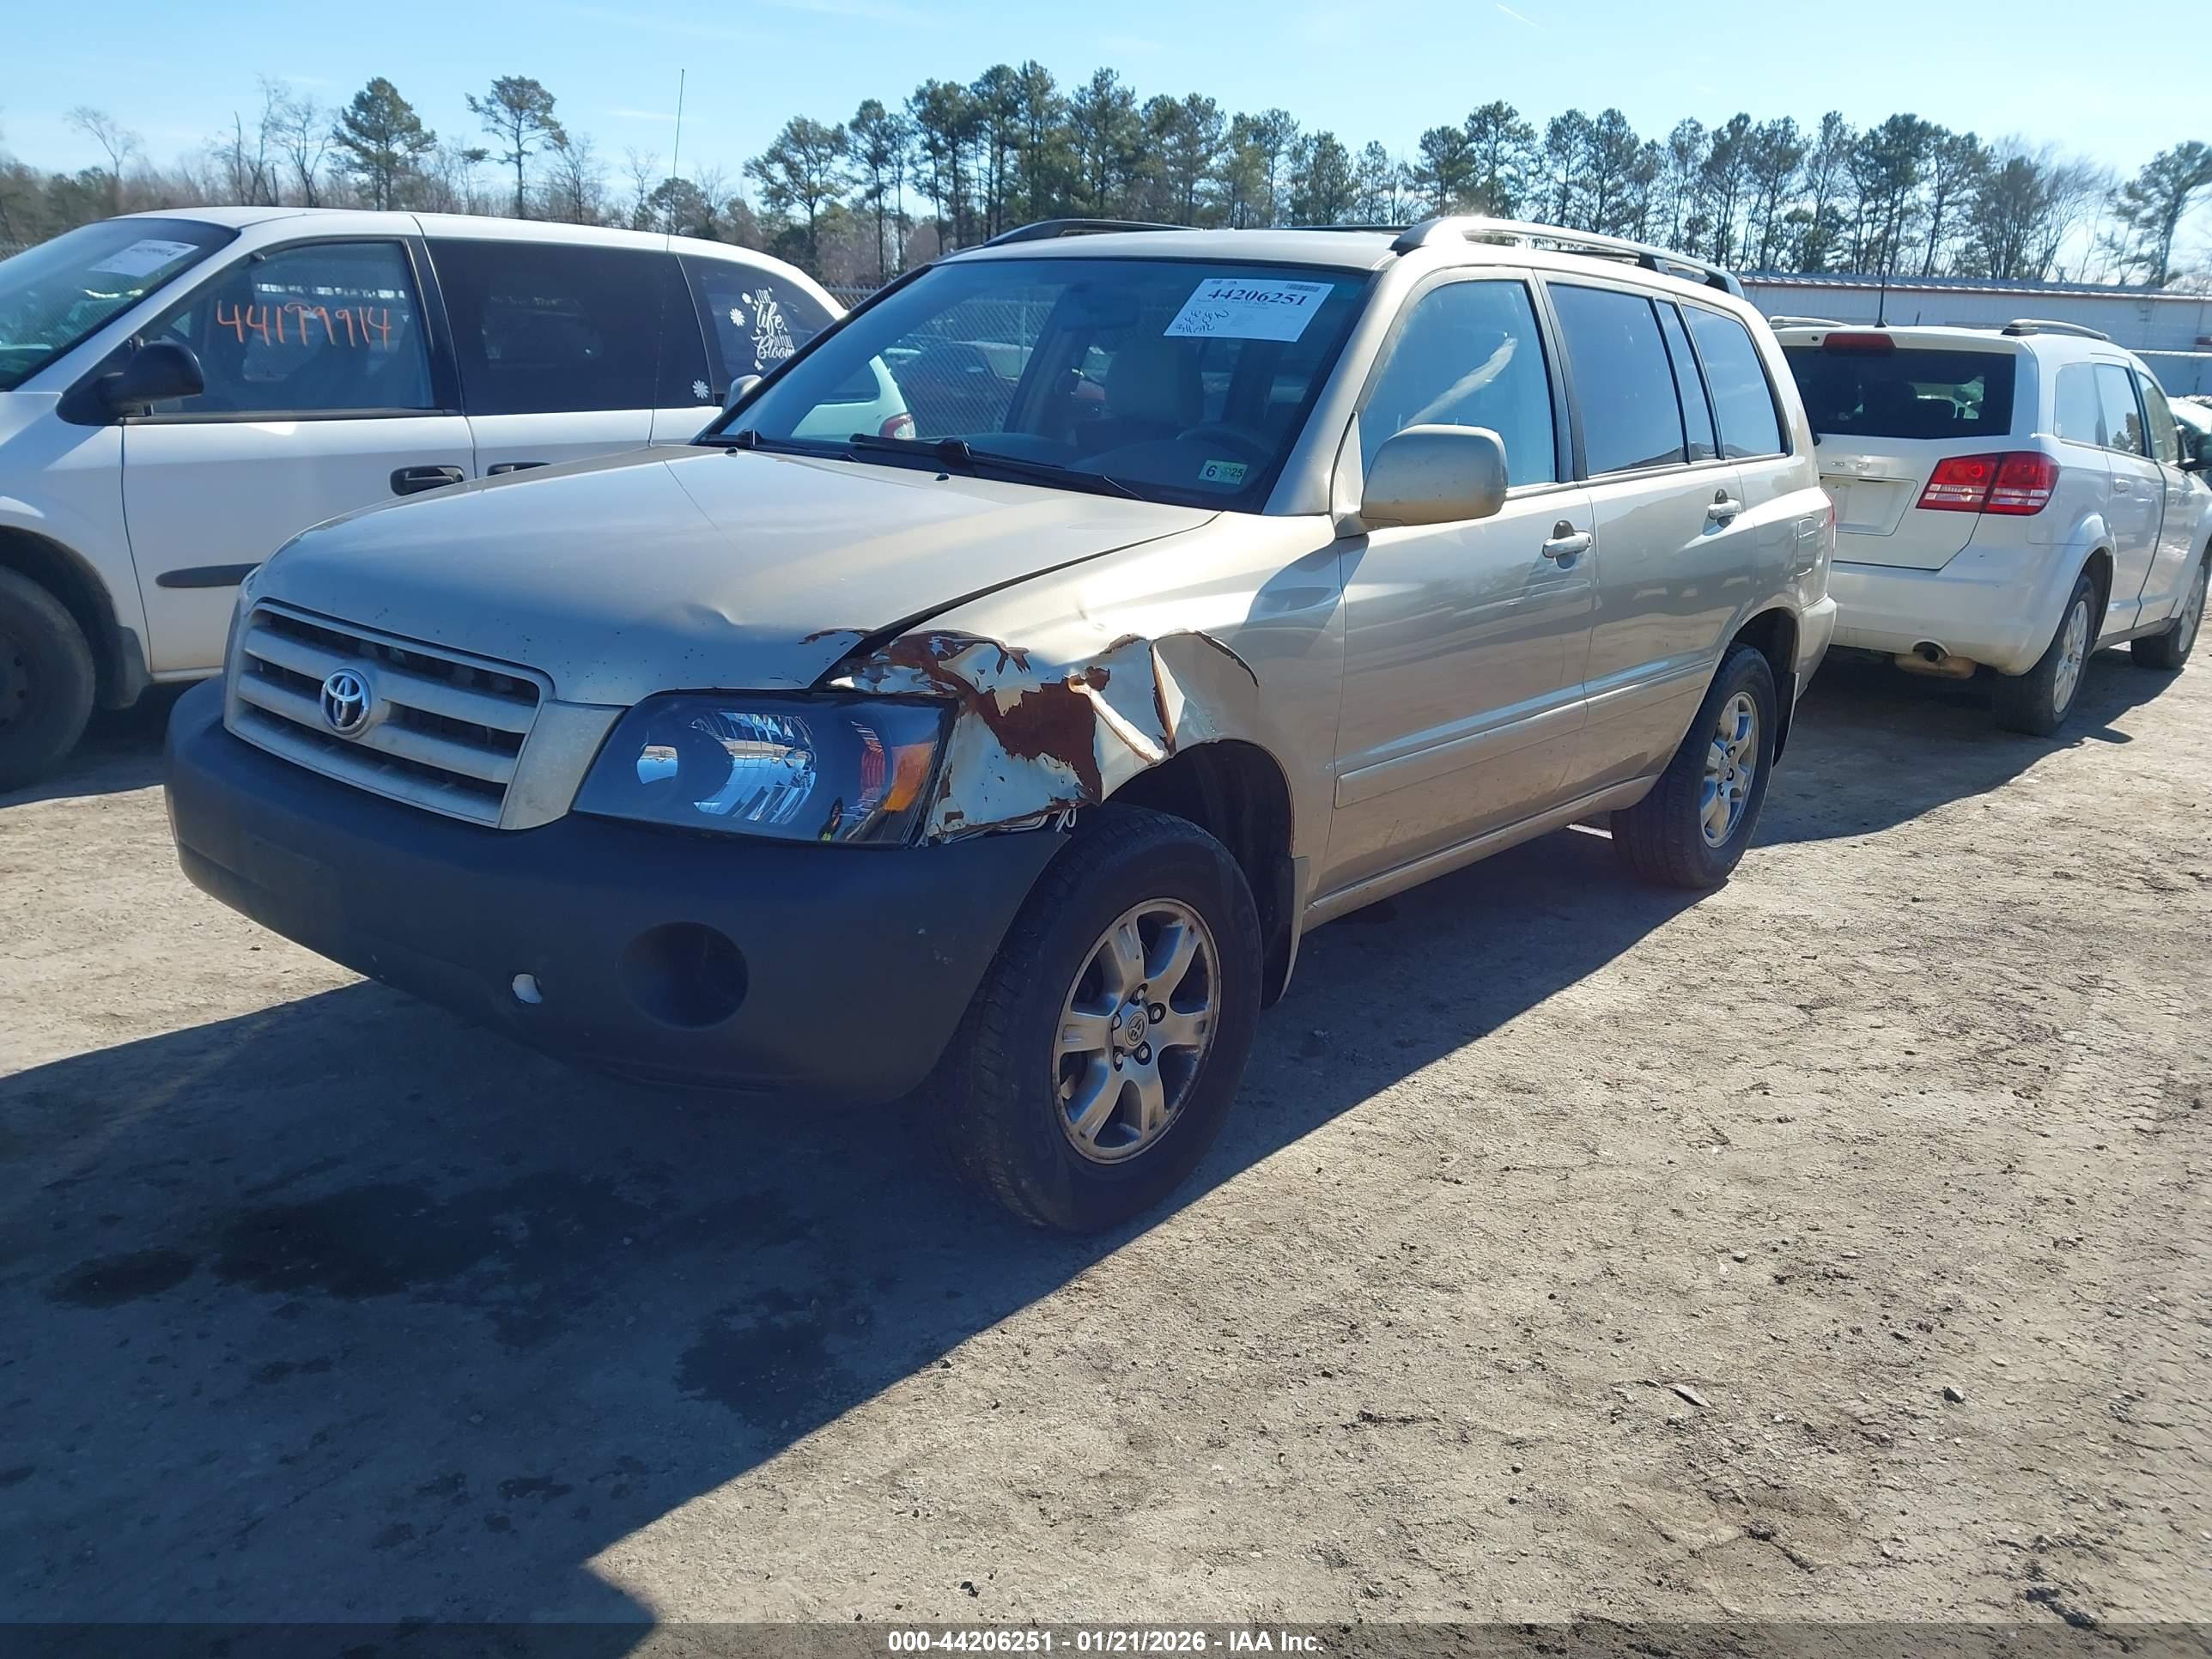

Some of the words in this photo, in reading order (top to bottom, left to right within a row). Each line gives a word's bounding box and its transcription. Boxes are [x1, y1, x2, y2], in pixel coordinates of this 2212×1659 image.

[1207, 289, 1308, 307] 44206251
[217, 300, 392, 350] 44179914
[1206, 465, 1218, 477] 6
[1231, 467, 1244, 477] 25
